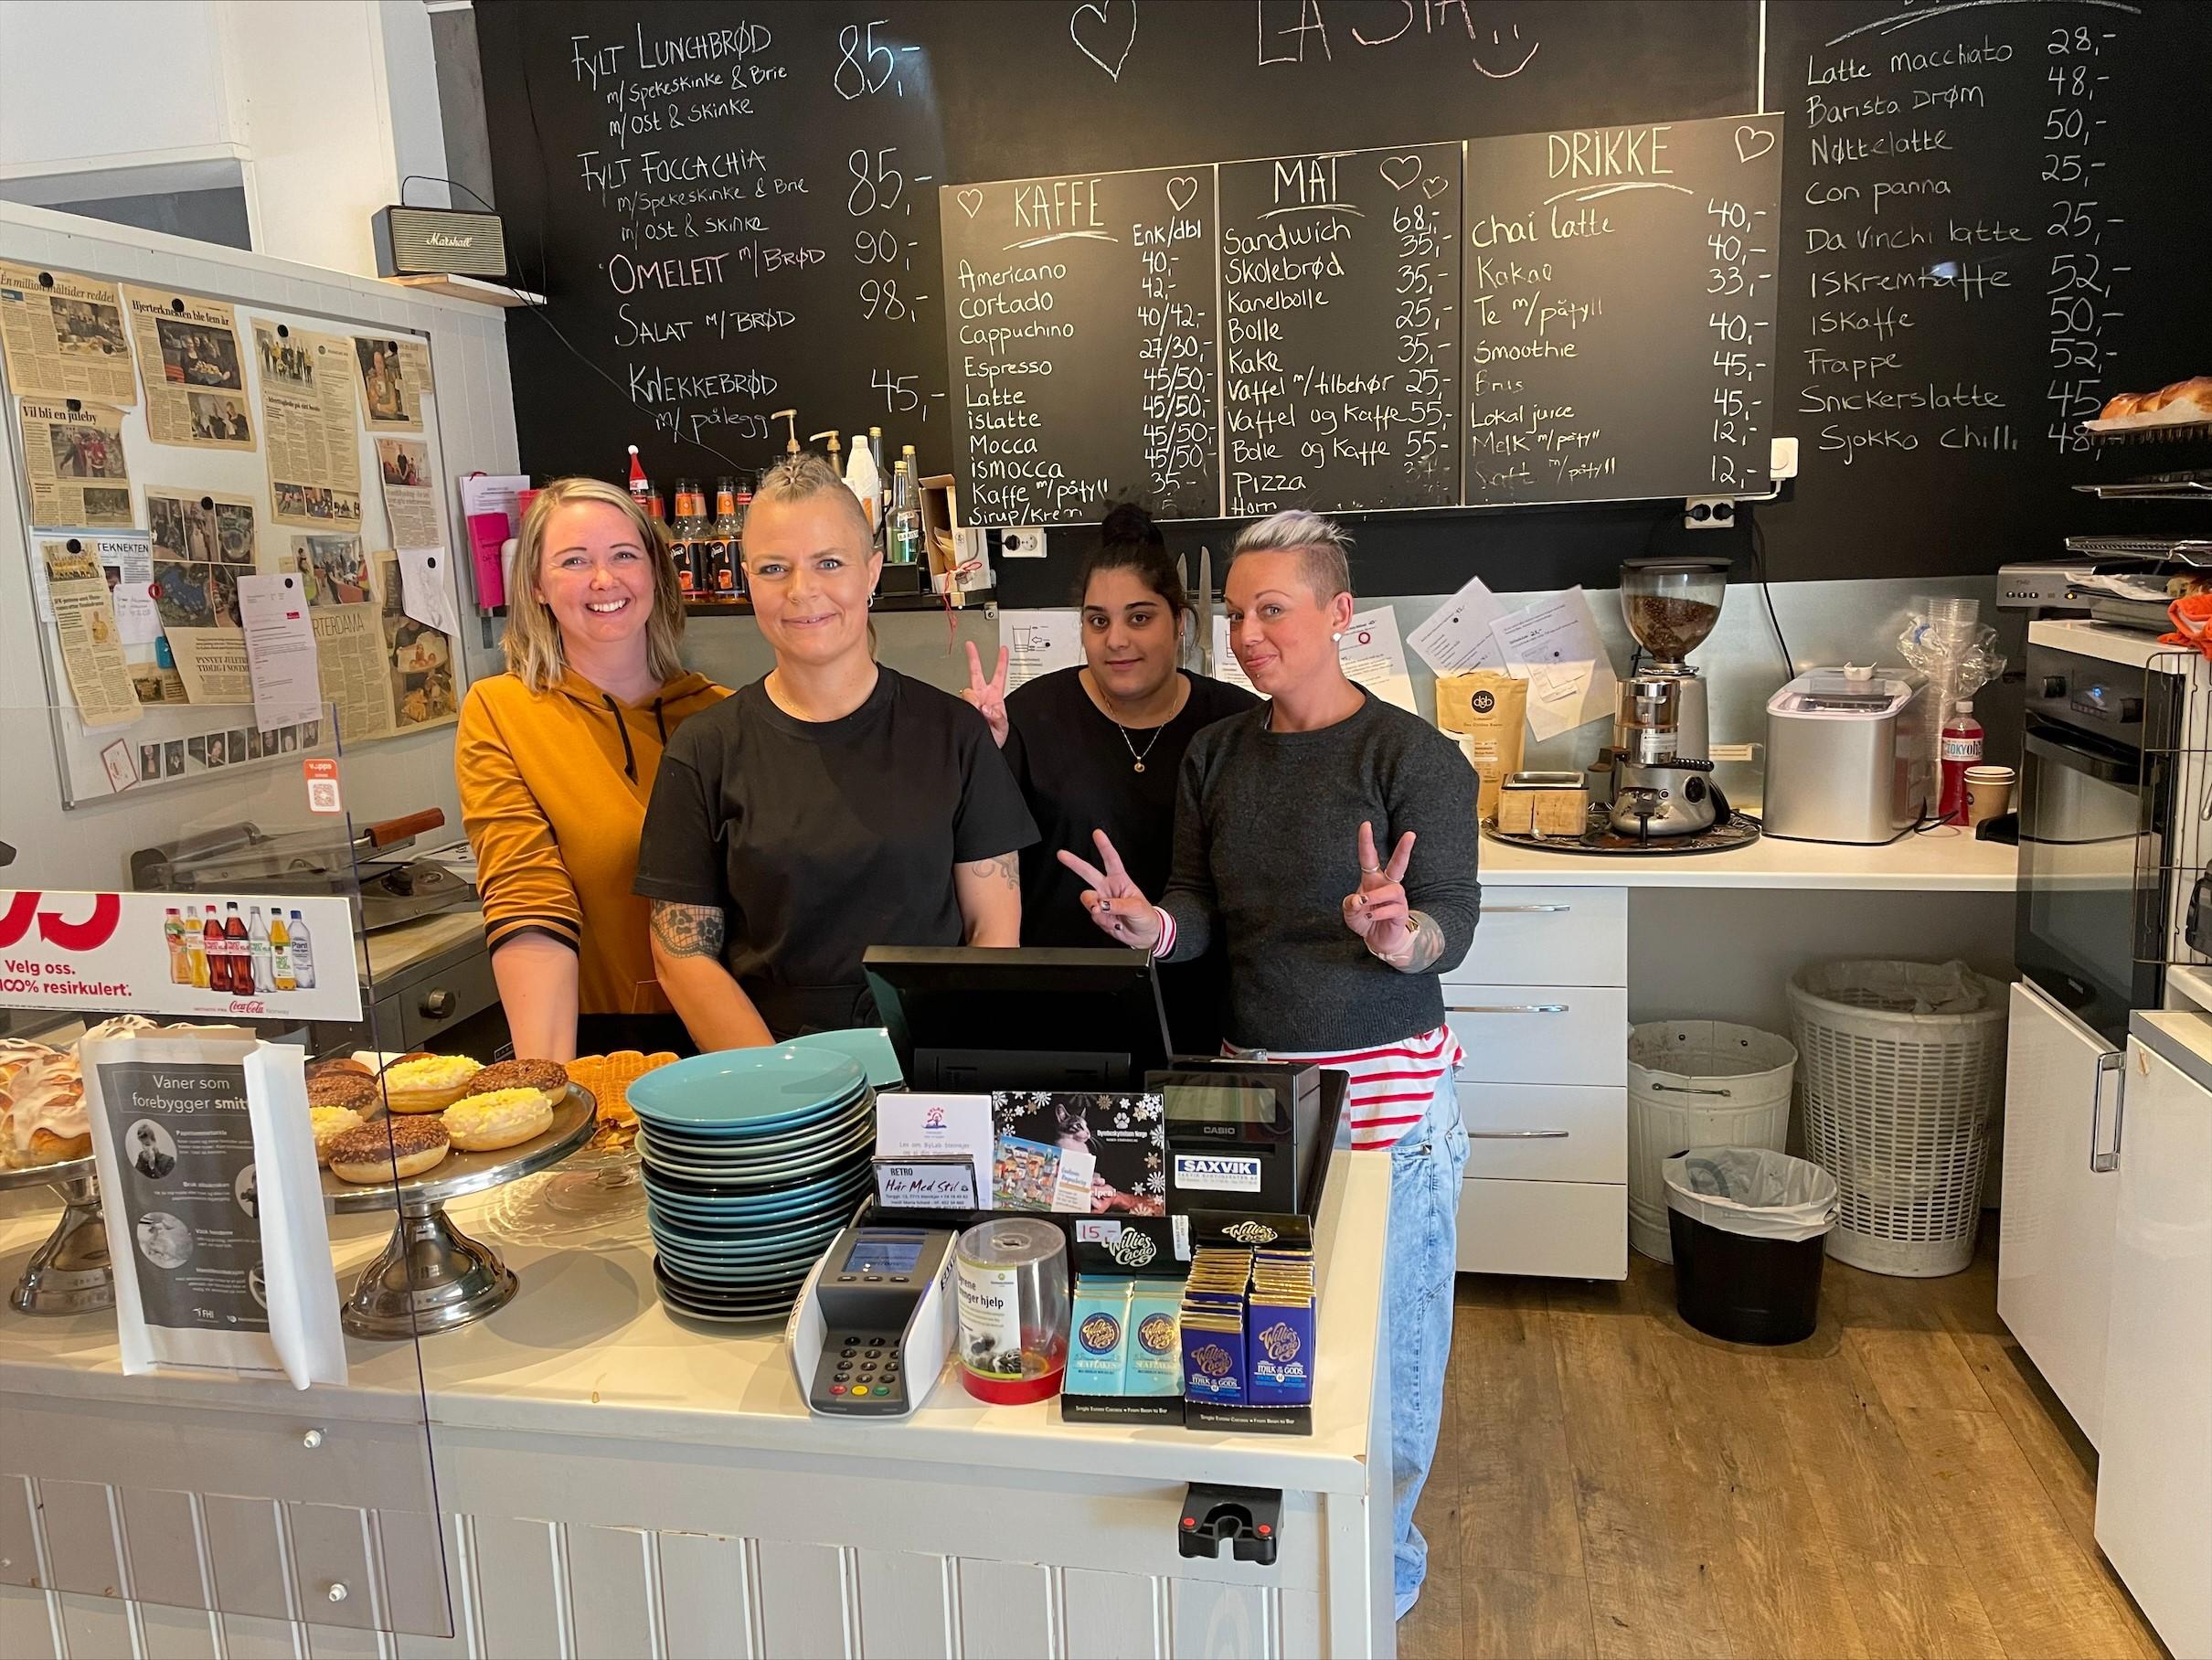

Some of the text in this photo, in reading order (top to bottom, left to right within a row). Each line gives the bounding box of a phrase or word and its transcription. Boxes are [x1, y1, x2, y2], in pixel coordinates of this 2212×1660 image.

[570, 35, 625, 90] FYLT
[834, 19, 920, 100] 85,-
[1807, 56, 1872, 86] Latte
[2047, 27, 2117, 57] 28,-
[731, 65, 747, 90] &
[750, 65, 788, 83] Brie
[1806, 95, 1901, 129] Barista
[2047, 66, 2110, 101] 48,-
[669, 108, 685, 128] &
[1812, 108, 2107, 165] Nøttelatte 50,-
[577, 150, 632, 208] FYLT
[847, 147, 932, 216] 85,-
[755, 177, 768, 197] &
[773, 178, 809, 195] Brie
[1274, 152, 1356, 204] MAT
[1805, 154, 2106, 215] Con panna 25,-
[1015, 179, 1104, 230] KAFFE
[1707, 198, 1767, 233] 40,-
[426, 232, 473, 248] Marshall
[686, 218, 698, 237] &
[1224, 204, 1440, 255] Sandwich 68,-
[1806, 229, 1845, 255] Da
[1950, 218, 2033, 242] latte
[2047, 201, 2125, 245] 25,-
[609, 251, 729, 293] OMELETT
[855, 229, 919, 271] 90,-
[958, 250, 1179, 293] Americano 40,-
[1225, 234, 1452, 285] Skolebrød 35,-
[1477, 235, 1767, 290] Kakao 40,-
[2047, 254, 2132, 298] 52,-
[87, 291, 114, 303] reddet
[959, 277, 1177, 320] Cortado 42,-
[1228, 263, 1449, 314] Kanelbolle 35,-
[1473, 294, 1502, 325] Te
[1707, 268, 1771, 297] 33,-
[193, 309, 206, 320] ble
[615, 303, 693, 346] SALAT
[860, 279, 928, 322] 98,-
[959, 303, 1205, 356] Cappuchino 40/42,-
[1228, 298, 1452, 344] Bolle 25,-
[2050, 297, 2125, 336] 50,-
[1228, 333, 1452, 374] Kake 35,-
[1473, 313, 1770, 365] Smoothie 40,-
[964, 331, 1213, 388] Espresso 27/30,-
[1713, 351, 1767, 381] 45,-
[1803, 338, 2118, 381] Frappe 52,-
[871, 368, 945, 421] 45,-
[965, 364, 1214, 408] Latte 45/50,-
[1228, 378, 1285, 405] Vaffel
[1405, 369, 1452, 400] 25,-
[1799, 383, 2006, 414] Snickerslatte
[22, 406, 97, 424] Vil bli en juleby
[1143, 393, 1211, 422] 45/50,-
[1228, 401, 1453, 439] Vaffel og Kaffe 55,-
[1471, 388, 1762, 434] Lokal juice 45,-
[970, 422, 1217, 454] Mocca 45/50,-
[1301, 441, 1324, 469] og
[1334, 438, 1390, 466] Kaffe
[1473, 420, 1757, 456] Melk 12,-
[1819, 424, 1919, 464] Sjokko
[1233, 472, 1306, 497] Pizza
[1712, 455, 1757, 489] 12,-
[973, 483, 1029, 509] Kaffe
[5, 960, 75, 975] Velg oss.
[154, 1075, 230, 1090] Vaner som
[132, 1094, 210, 1113] forebygger
[1203, 1126, 1236, 1134] CASIO
[909, 1179, 935, 1192] Med
[938, 1180, 960, 1193] Stil
[1184, 1160, 1251, 1174] SAXVIK
[202, 1308, 215, 1318] FHI
[981, 1295, 1004, 1309] hjelp
